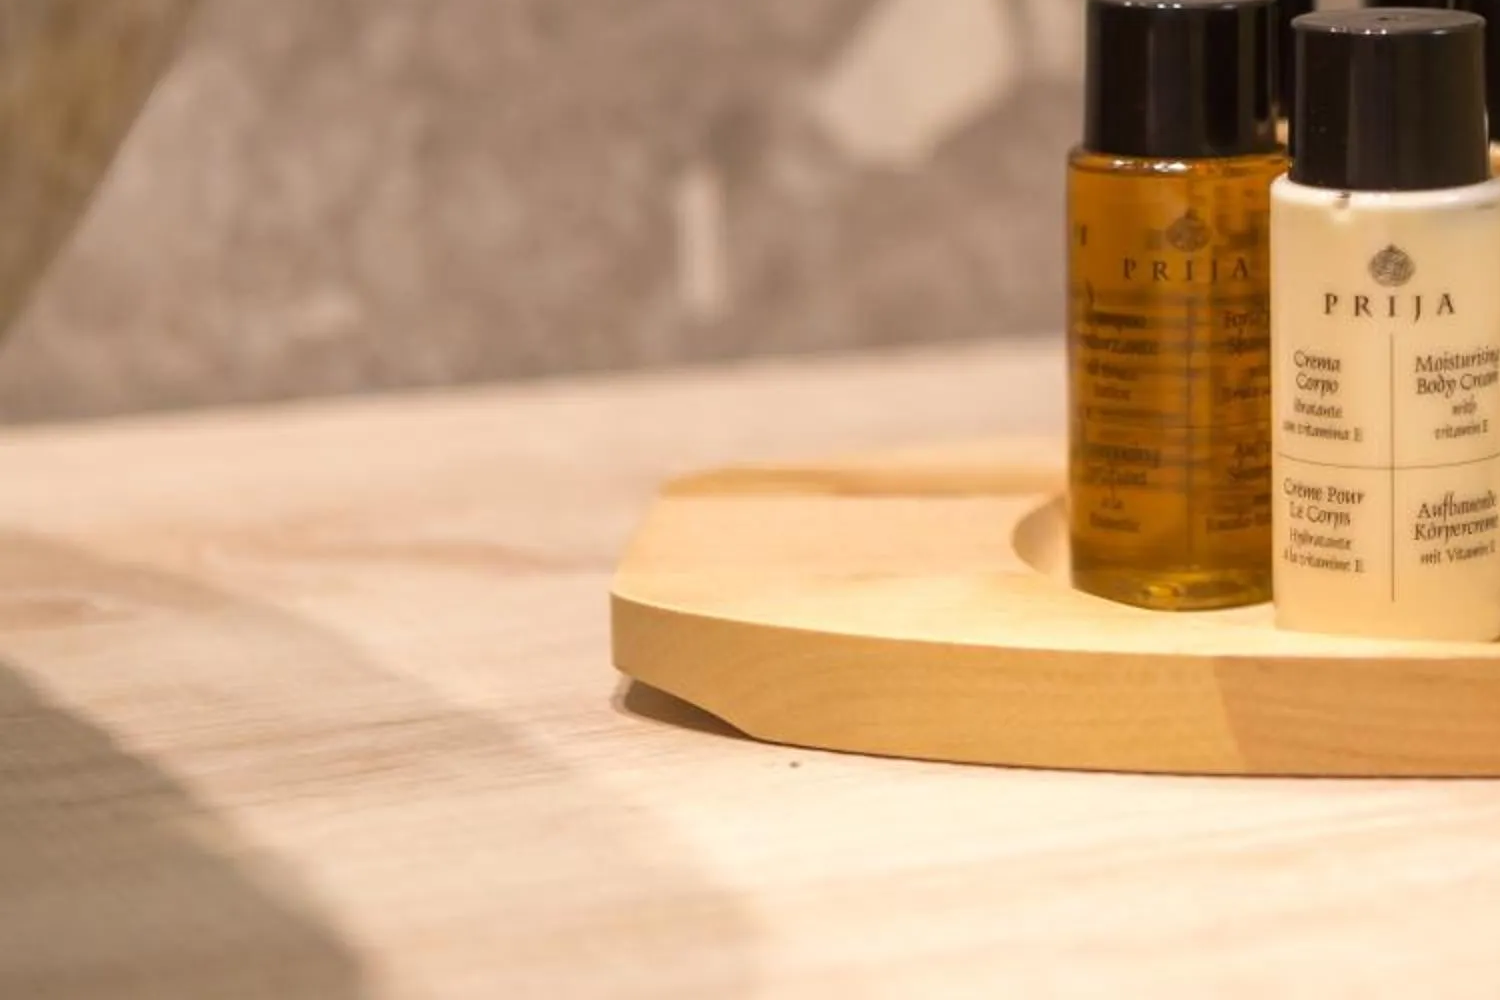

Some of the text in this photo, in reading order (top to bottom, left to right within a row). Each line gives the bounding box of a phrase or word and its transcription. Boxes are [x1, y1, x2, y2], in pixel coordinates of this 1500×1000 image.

[1122, 256, 1249, 287] PRIJA
[1323, 292, 1457, 322] PRIJA
[1293, 350, 1342, 373] Crema
[1295, 372, 1340, 399] Corpo
[1416, 370, 1499, 399] Body Cream
[1452, 394, 1478, 416] with
[1353, 427, 1364, 442] E
[1327, 486, 1366, 505] Pour
[1289, 501, 1351, 530] Le Corps
[1420, 547, 1441, 564] mit
